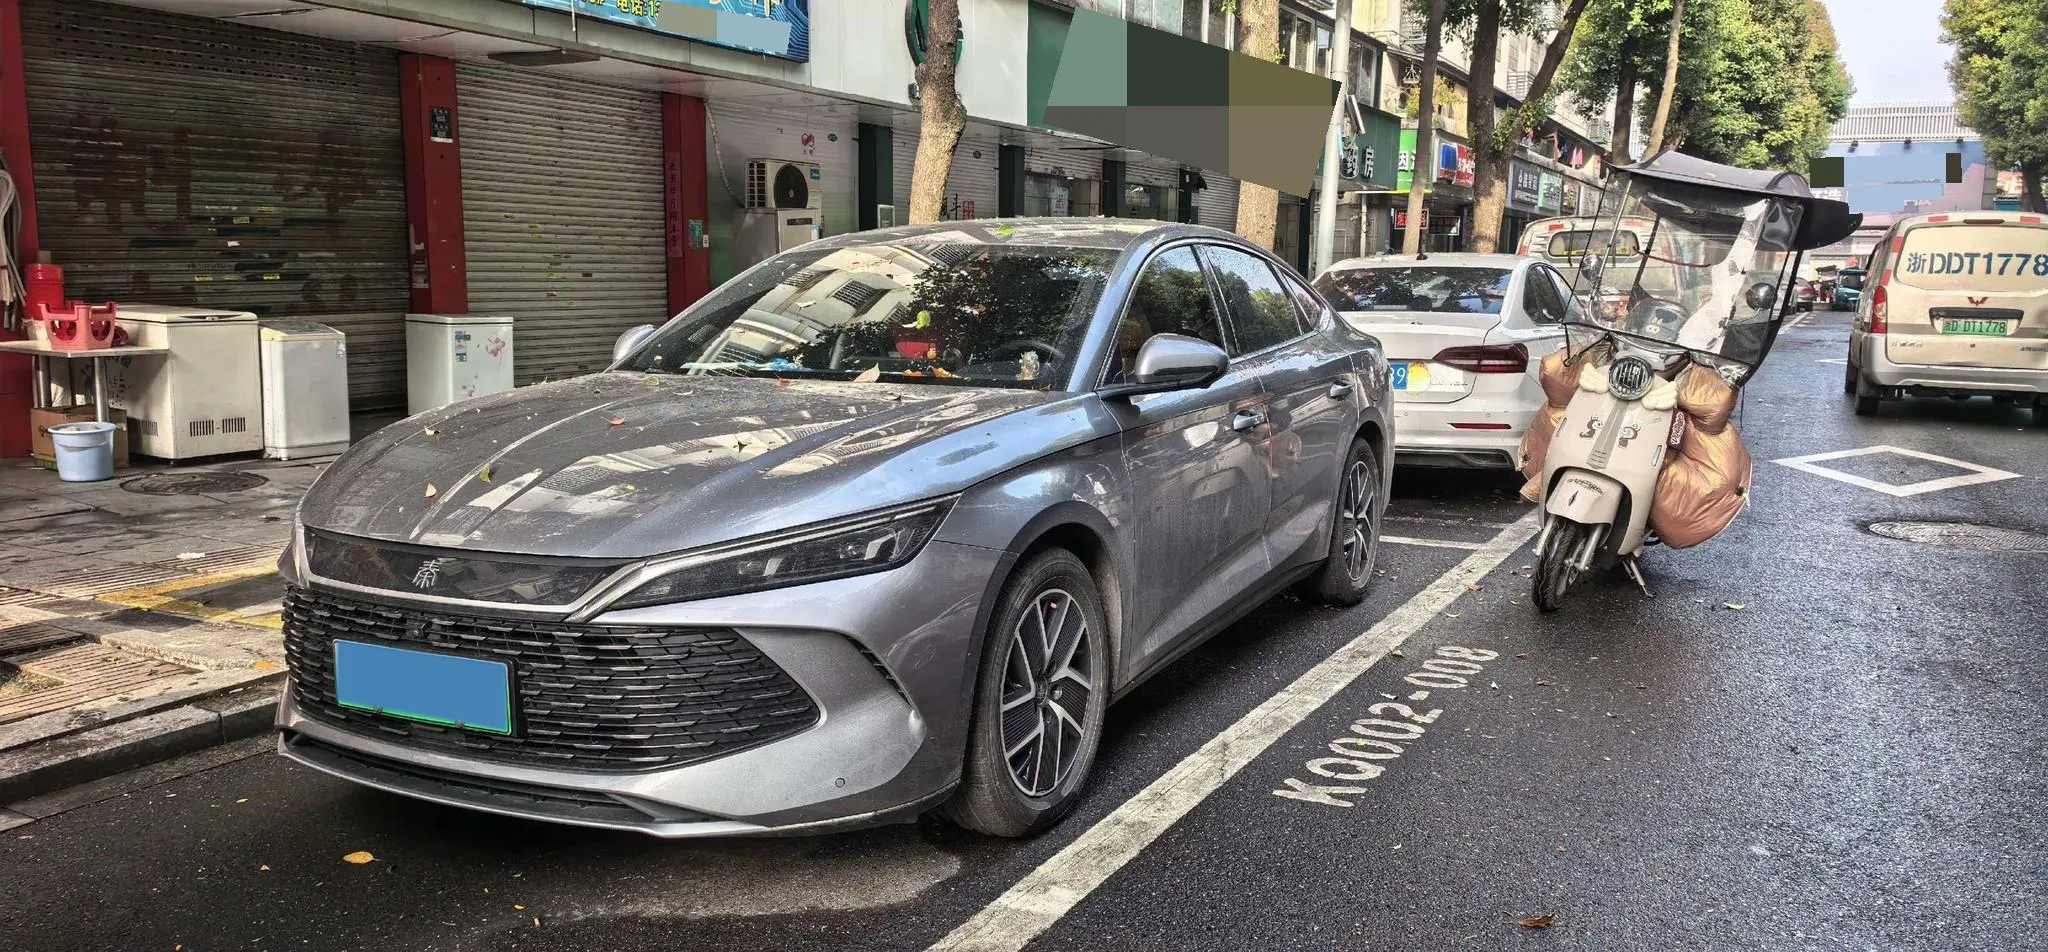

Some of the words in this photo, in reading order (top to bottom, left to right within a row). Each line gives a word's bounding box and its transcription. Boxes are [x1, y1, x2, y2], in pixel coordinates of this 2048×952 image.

[1907, 252, 2048, 276] 浙DDT1778
[412, 559, 441, 588] 秦
[1273, 647, 1499, 807] KQ002-008
